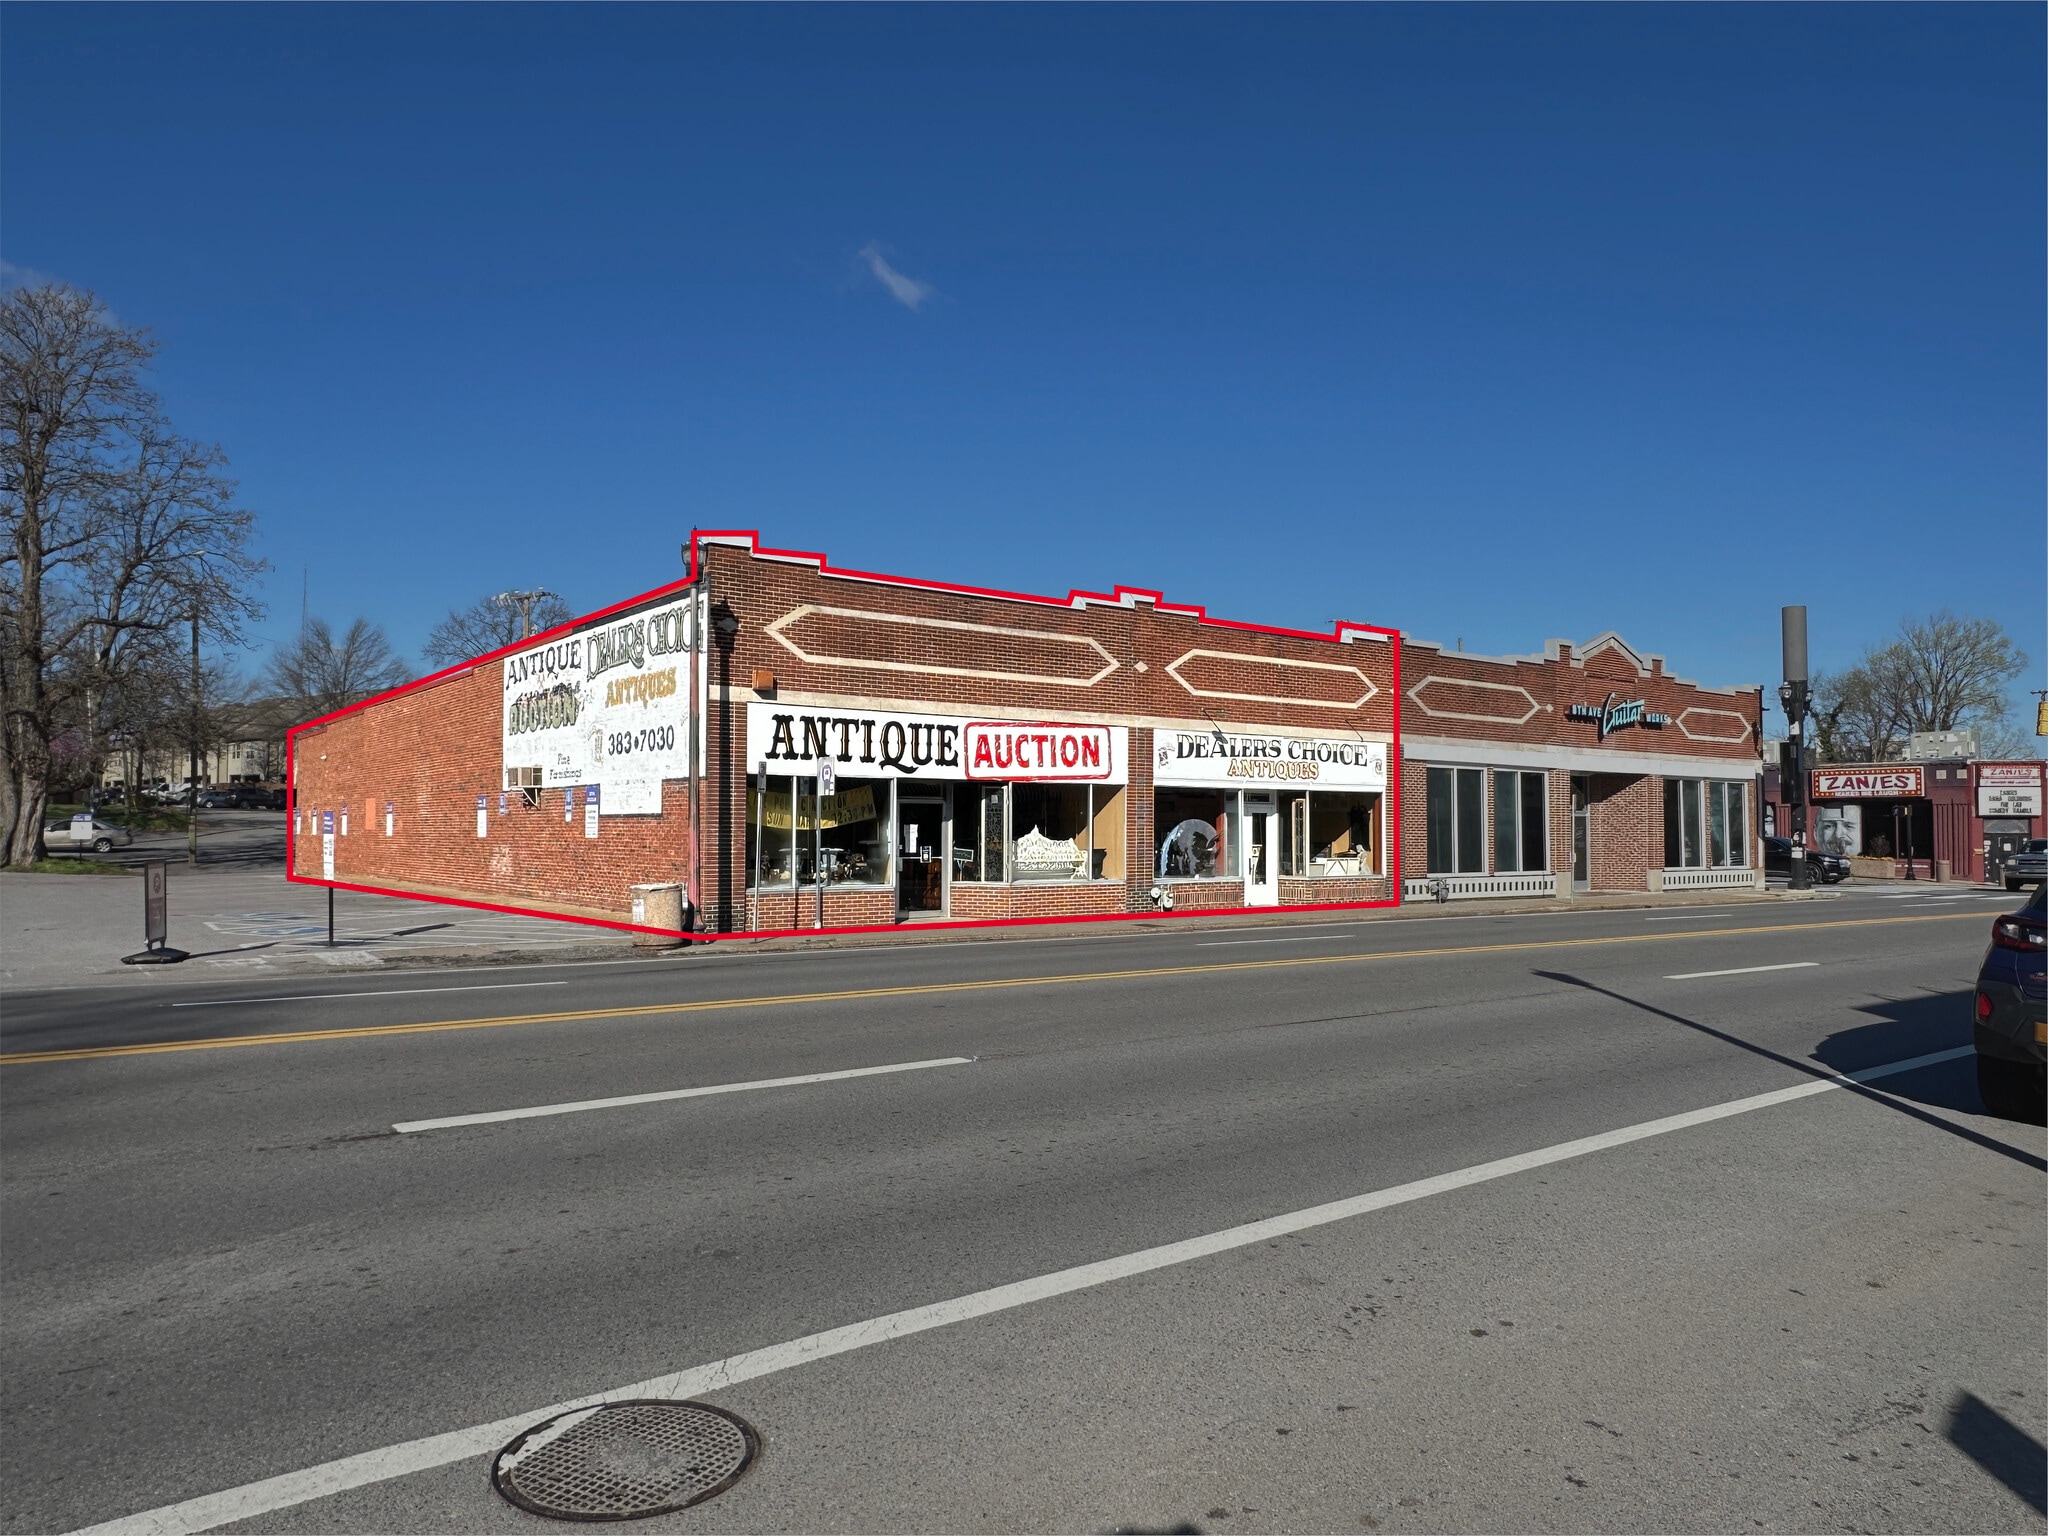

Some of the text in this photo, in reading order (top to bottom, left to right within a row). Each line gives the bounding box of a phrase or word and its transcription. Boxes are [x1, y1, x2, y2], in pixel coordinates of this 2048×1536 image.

[506, 639, 582, 690] ANTIQUE
[587, 619, 646, 682] DEALERS
[605, 666, 677, 710] ANTIQUES
[766, 713, 1100, 774] ANTIQUE AUCTION
[1176, 734, 1368, 767] DEALERS CHOICE
[1227, 758, 1319, 780] ANTIQUES
[1825, 775, 1910, 790] ZANIES
[767, 812, 784, 826] SUN
